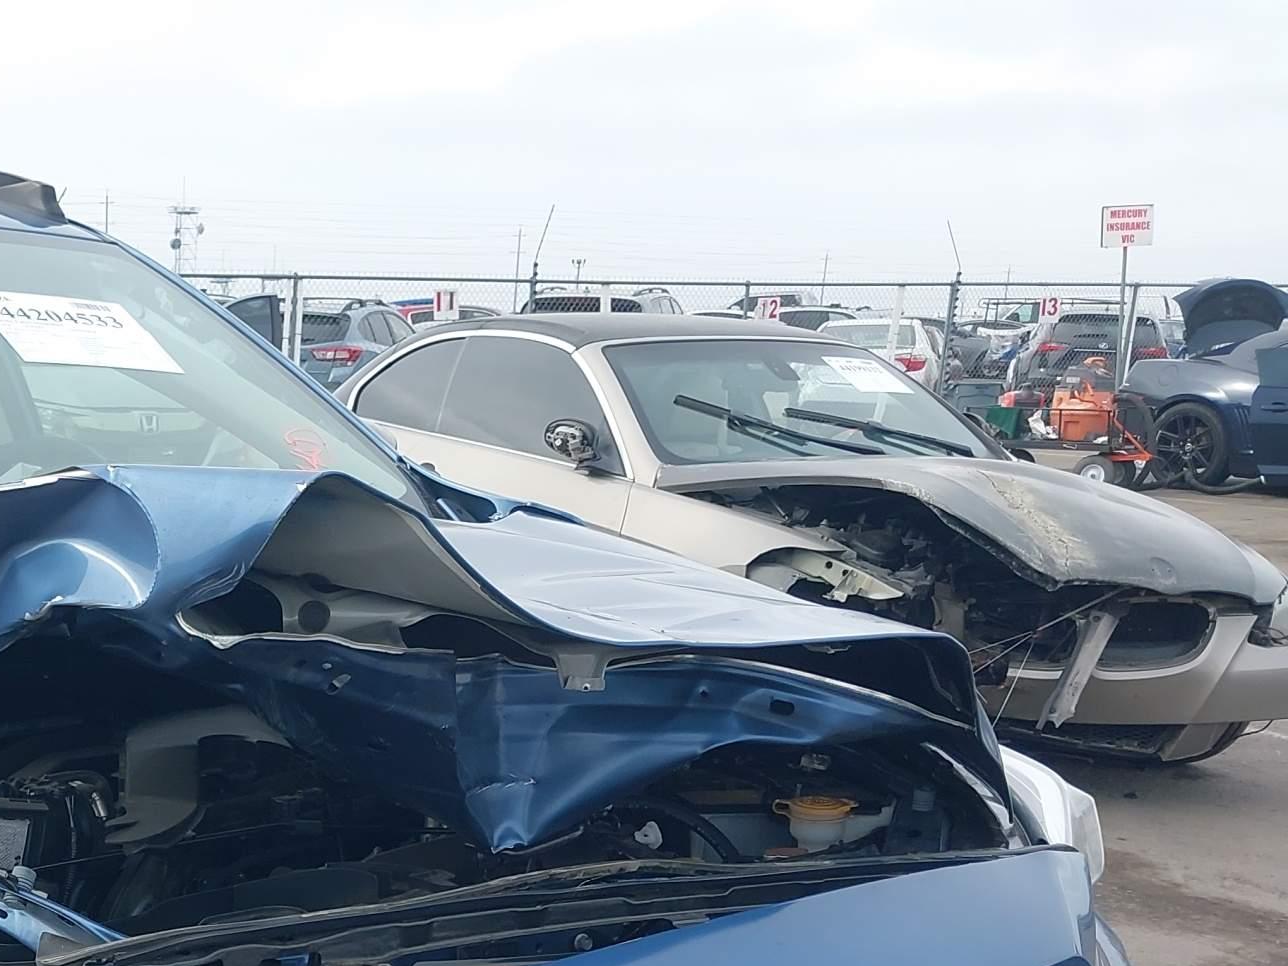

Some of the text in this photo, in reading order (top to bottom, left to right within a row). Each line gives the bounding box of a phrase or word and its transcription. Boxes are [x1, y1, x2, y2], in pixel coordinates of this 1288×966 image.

[1110, 208, 1148, 219] MERCURY
[1106, 221, 1152, 232] INSURANCE
[1121, 234, 1135, 243] VIC
[762, 300, 778, 318] 12
[1041, 297, 1058, 316] 13
[0, 306, 124, 329] 44204533
